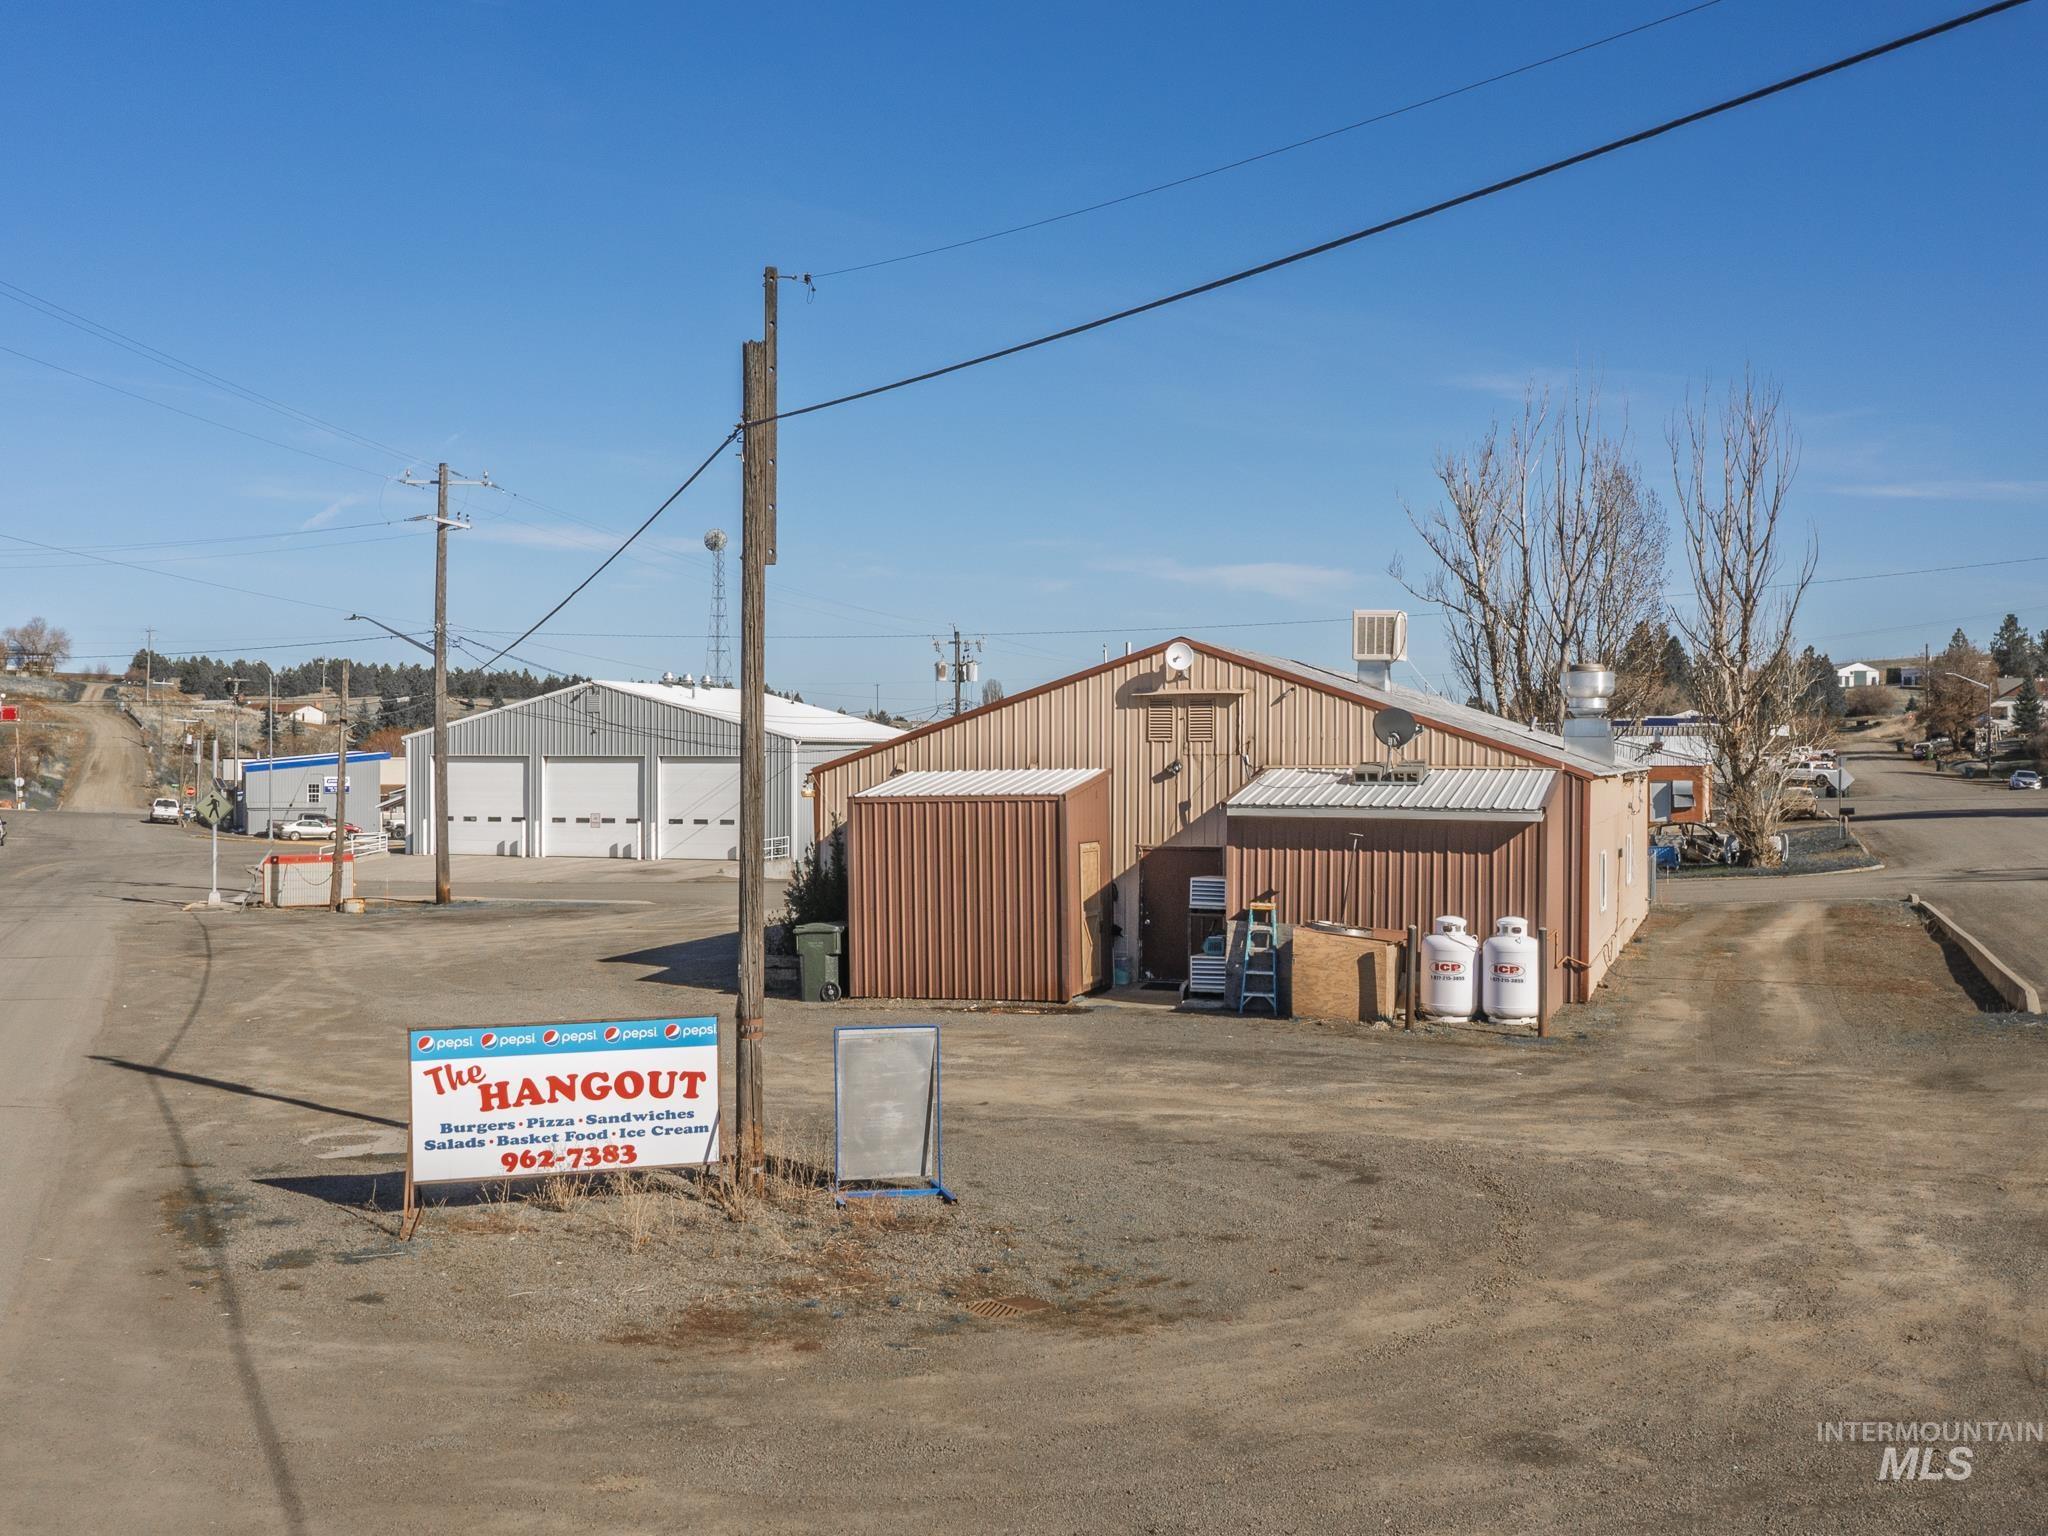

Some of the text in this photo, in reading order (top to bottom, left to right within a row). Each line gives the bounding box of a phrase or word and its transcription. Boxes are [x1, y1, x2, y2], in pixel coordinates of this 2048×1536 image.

[1434, 963, 1461, 972] ICP
[1493, 964, 1520, 974] ICP
[436, 1023, 717, 1051] pepsi pepsi pepsi pepsi pepsi
[423, 1064, 707, 1112] The HANGOUT
[439, 1109, 695, 1134] Burgers Pizza Sandwiches
[424, 1124, 710, 1151] Salads Basket Food Ice Cream
[500, 1144, 638, 1173] 962-7383
